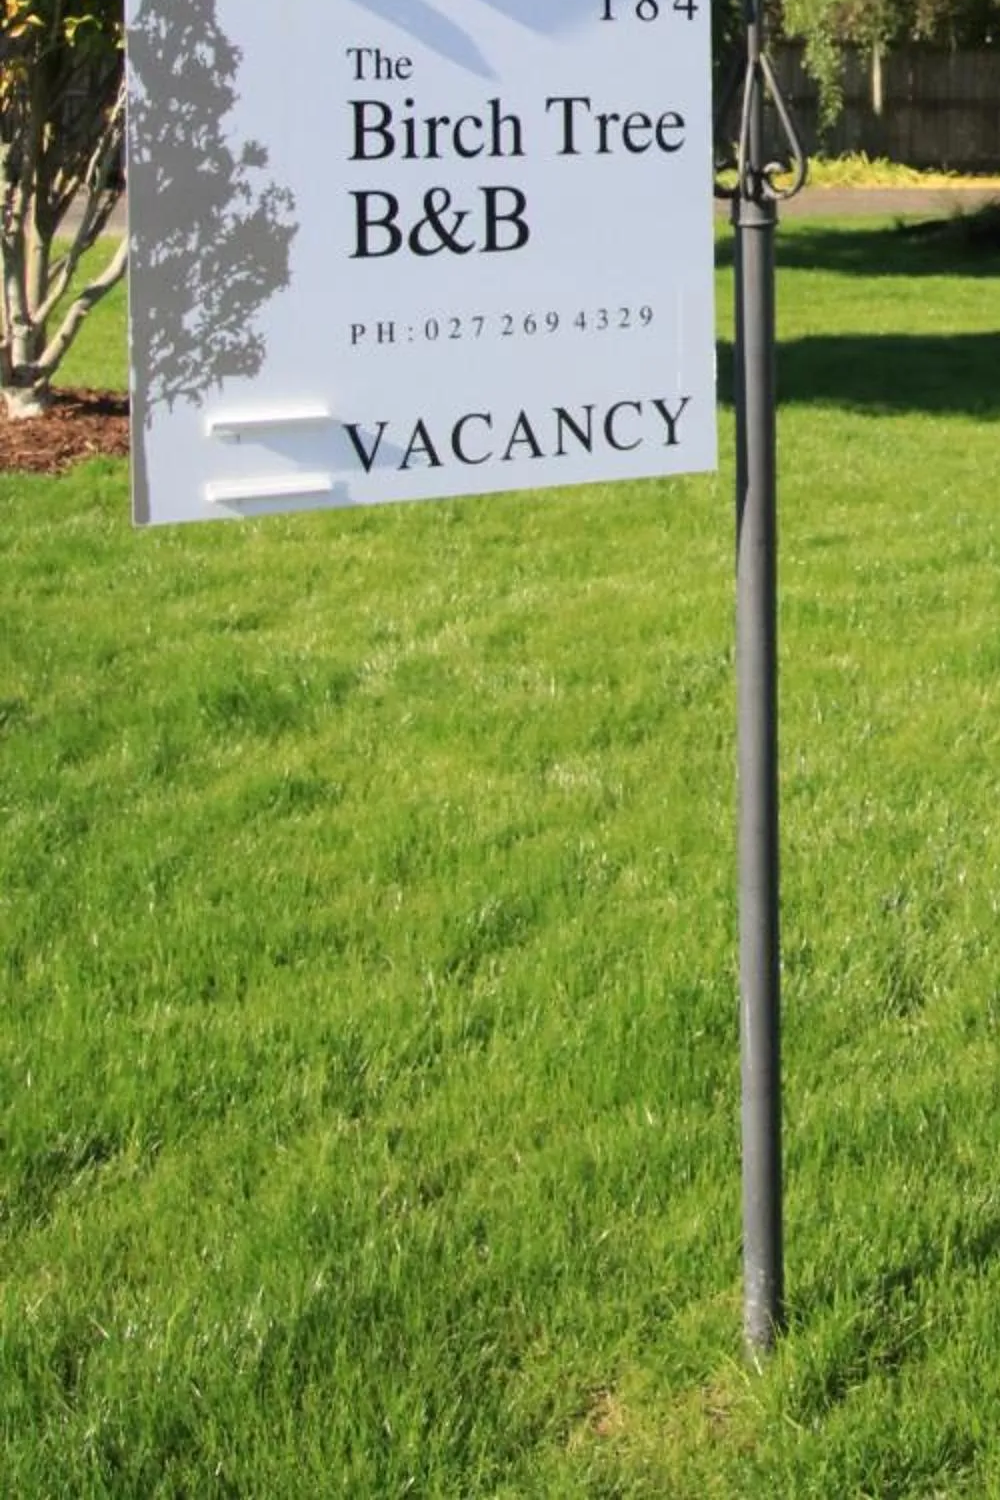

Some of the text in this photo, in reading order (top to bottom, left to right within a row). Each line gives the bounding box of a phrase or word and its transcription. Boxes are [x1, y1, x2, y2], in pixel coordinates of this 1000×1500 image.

[346, 46, 414, 81] The
[346, 95, 687, 162] Birch Tree
[347, 185, 531, 260] B&B
[341, 396, 694, 476] VACANCY
